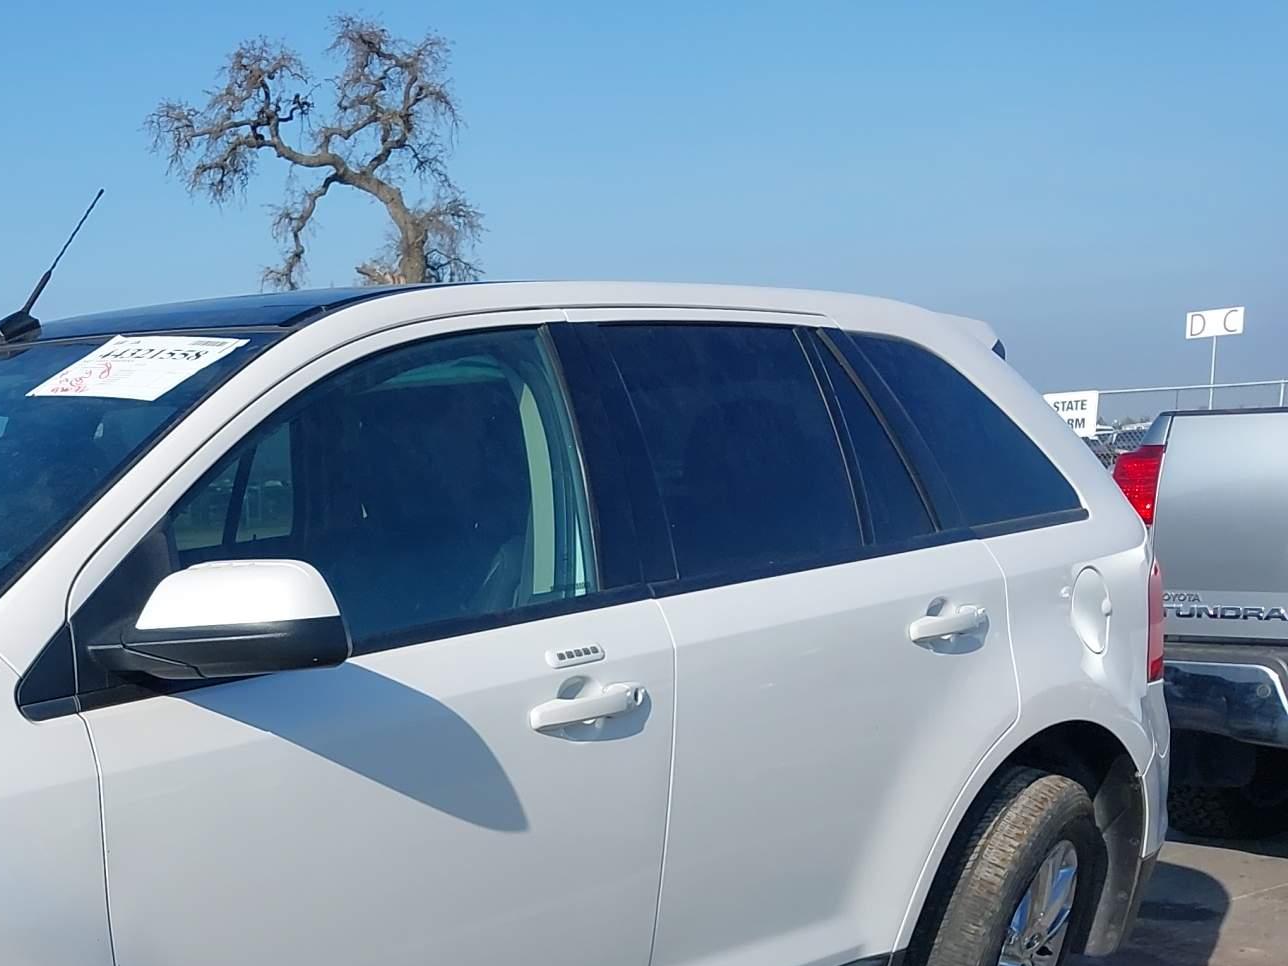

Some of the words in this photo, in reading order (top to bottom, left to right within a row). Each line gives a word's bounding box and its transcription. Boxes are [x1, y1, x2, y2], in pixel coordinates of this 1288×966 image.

[1190, 313, 1206, 337] D
[1223, 309, 1239, 333] C
[98, 348, 209, 361] 44321558
[1053, 399, 1088, 412] STATE
[1162, 592, 1202, 603] OYOTA
[1162, 603, 1288, 621] TUNDRA
